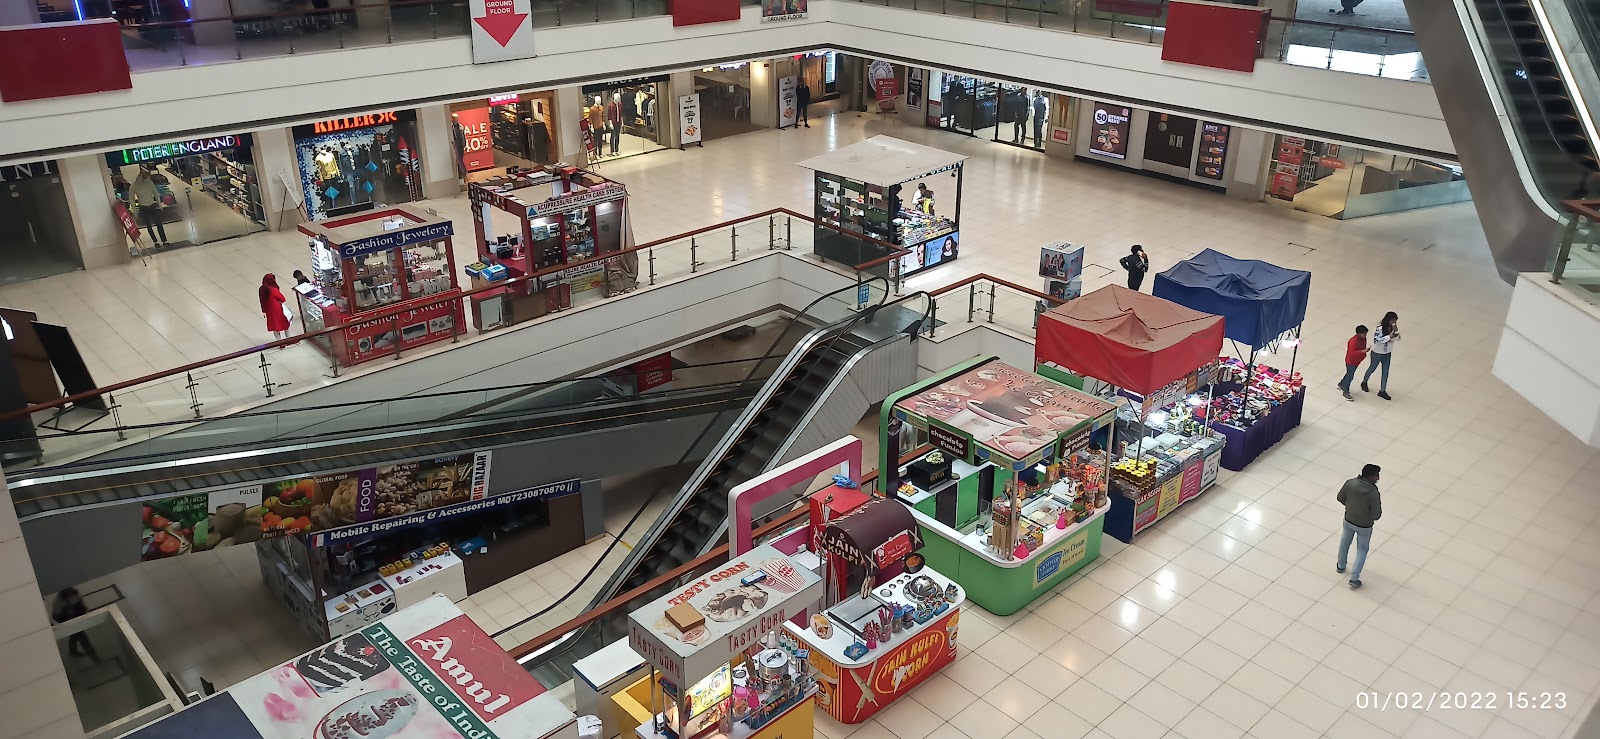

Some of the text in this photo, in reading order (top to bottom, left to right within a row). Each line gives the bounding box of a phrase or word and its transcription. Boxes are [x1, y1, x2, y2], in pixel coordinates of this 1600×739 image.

[486, 0, 513, 8] GROUND
[314, 112, 376, 133] KILLER
[1097, 112, 1107, 122] 50
[133, 136, 235, 161] PETER ENGLAND
[344, 224, 449, 256] Fashion Jewelery
[239, 488, 259, 496] PULSES
[316, 476, 334, 484] GLOBAL
[473, 454, 487, 501] BIG BAZAAR
[360, 479, 372, 512] FOOD
[330, 527, 369, 541] Mobile
[371, 513, 426, 532] Repairing
[438, 499, 496, 518] Accessories
[828, 536, 859, 557] JAIN
[828, 544, 859, 565] KULFI
[667, 578, 711, 607] TESTY
[709, 561, 750, 583] CORN
[728, 628, 758, 653] TASTY
[760, 608, 786, 634] CORN
[632, 626, 658, 656] TASTY
[658, 648, 681, 679] CORN
[881, 633, 939, 679] JAIN KULFI
[369, 626, 400, 658] The
[396, 655, 437, 695] Taste
[434, 695, 459, 714] Of
[411, 636, 512, 715] Amul
